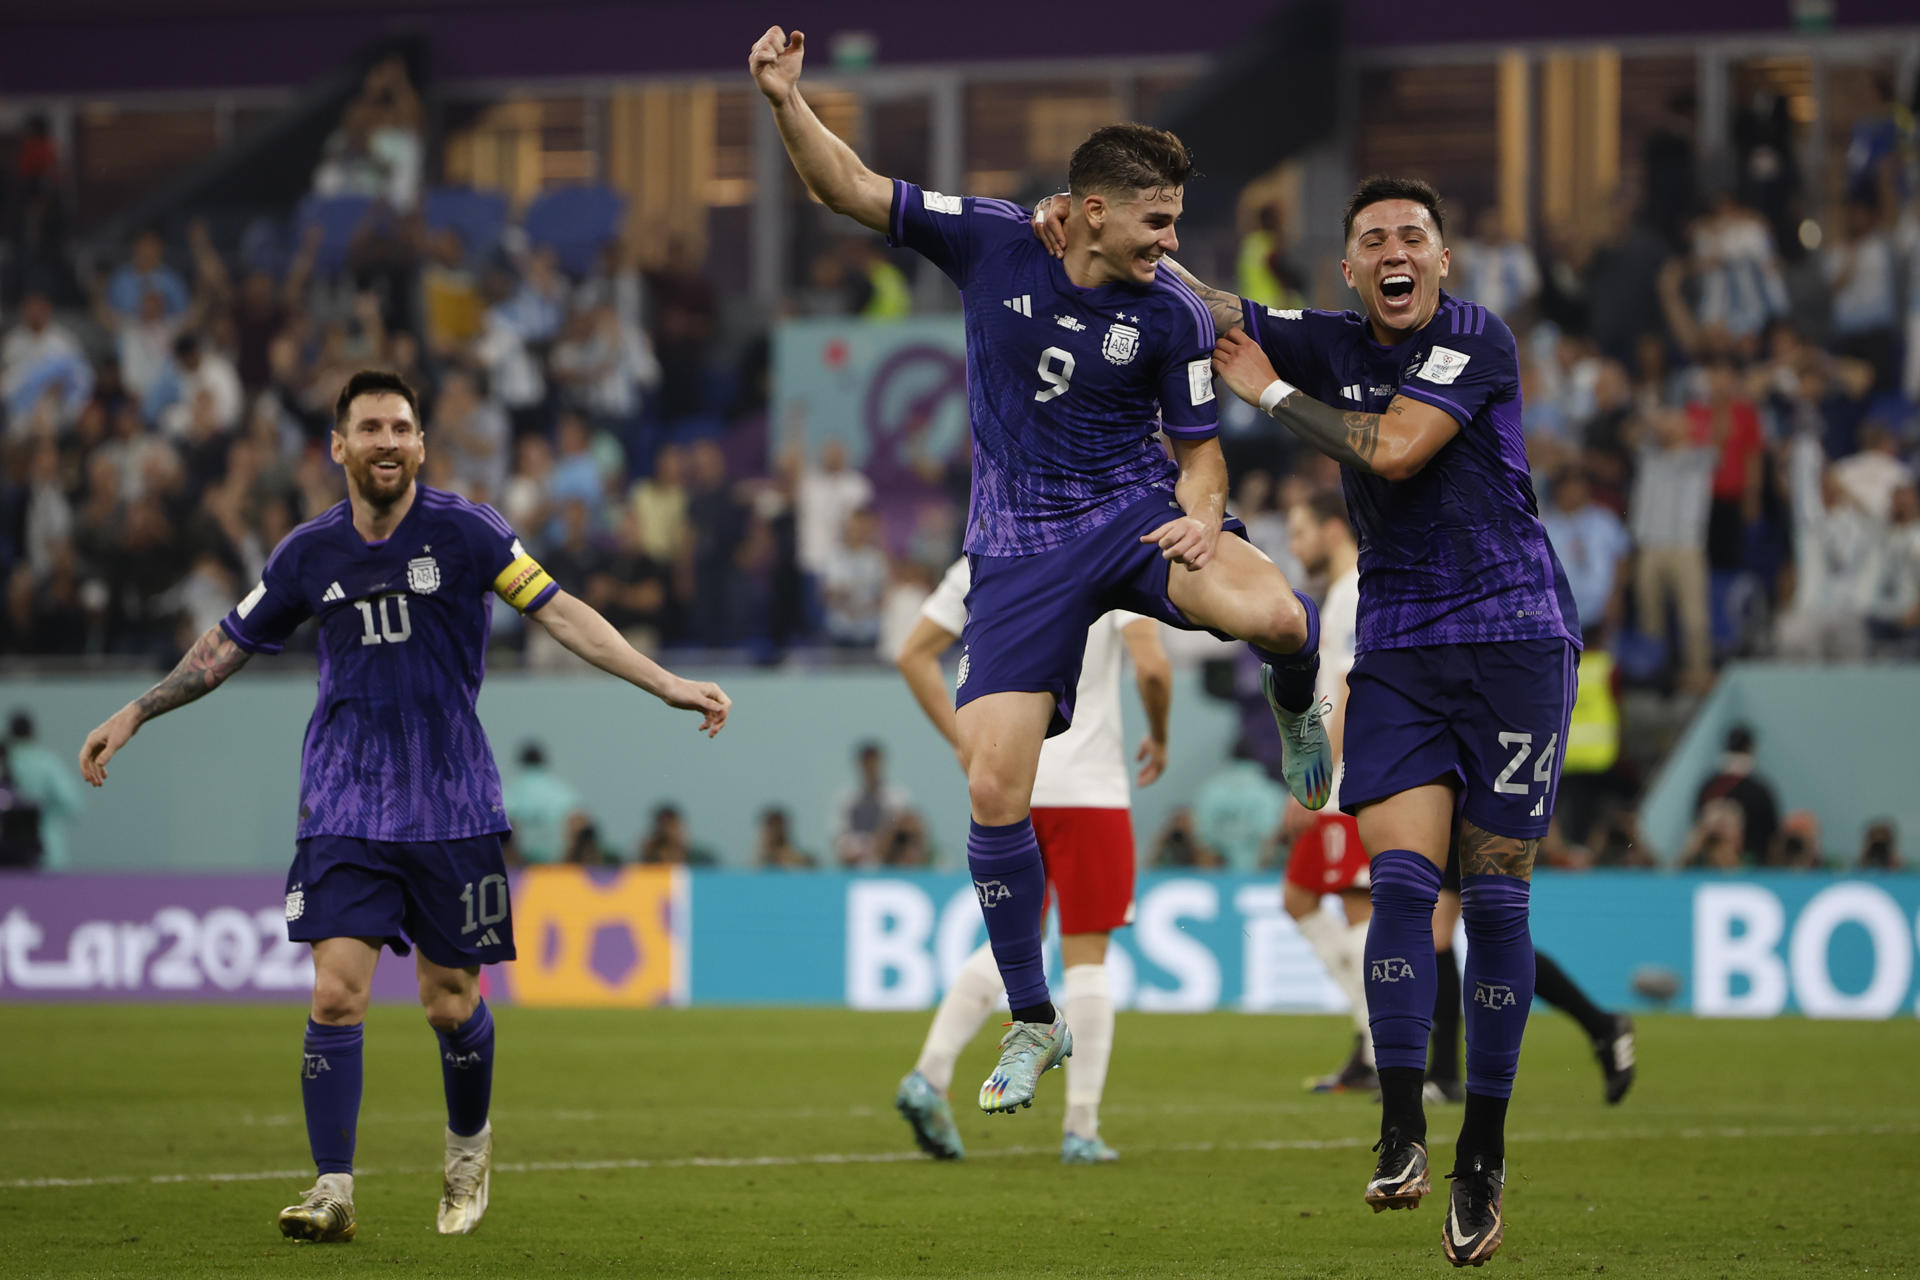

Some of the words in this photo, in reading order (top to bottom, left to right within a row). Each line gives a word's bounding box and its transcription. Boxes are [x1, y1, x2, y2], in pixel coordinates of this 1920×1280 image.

[1034, 346, 1076, 402] 9
[354, 594, 412, 646] 10
[1493, 731, 1558, 795] 24
[459, 872, 508, 935] 10
[844, 876, 1223, 1012] BS
[1692, 880, 1920, 1020] BO
